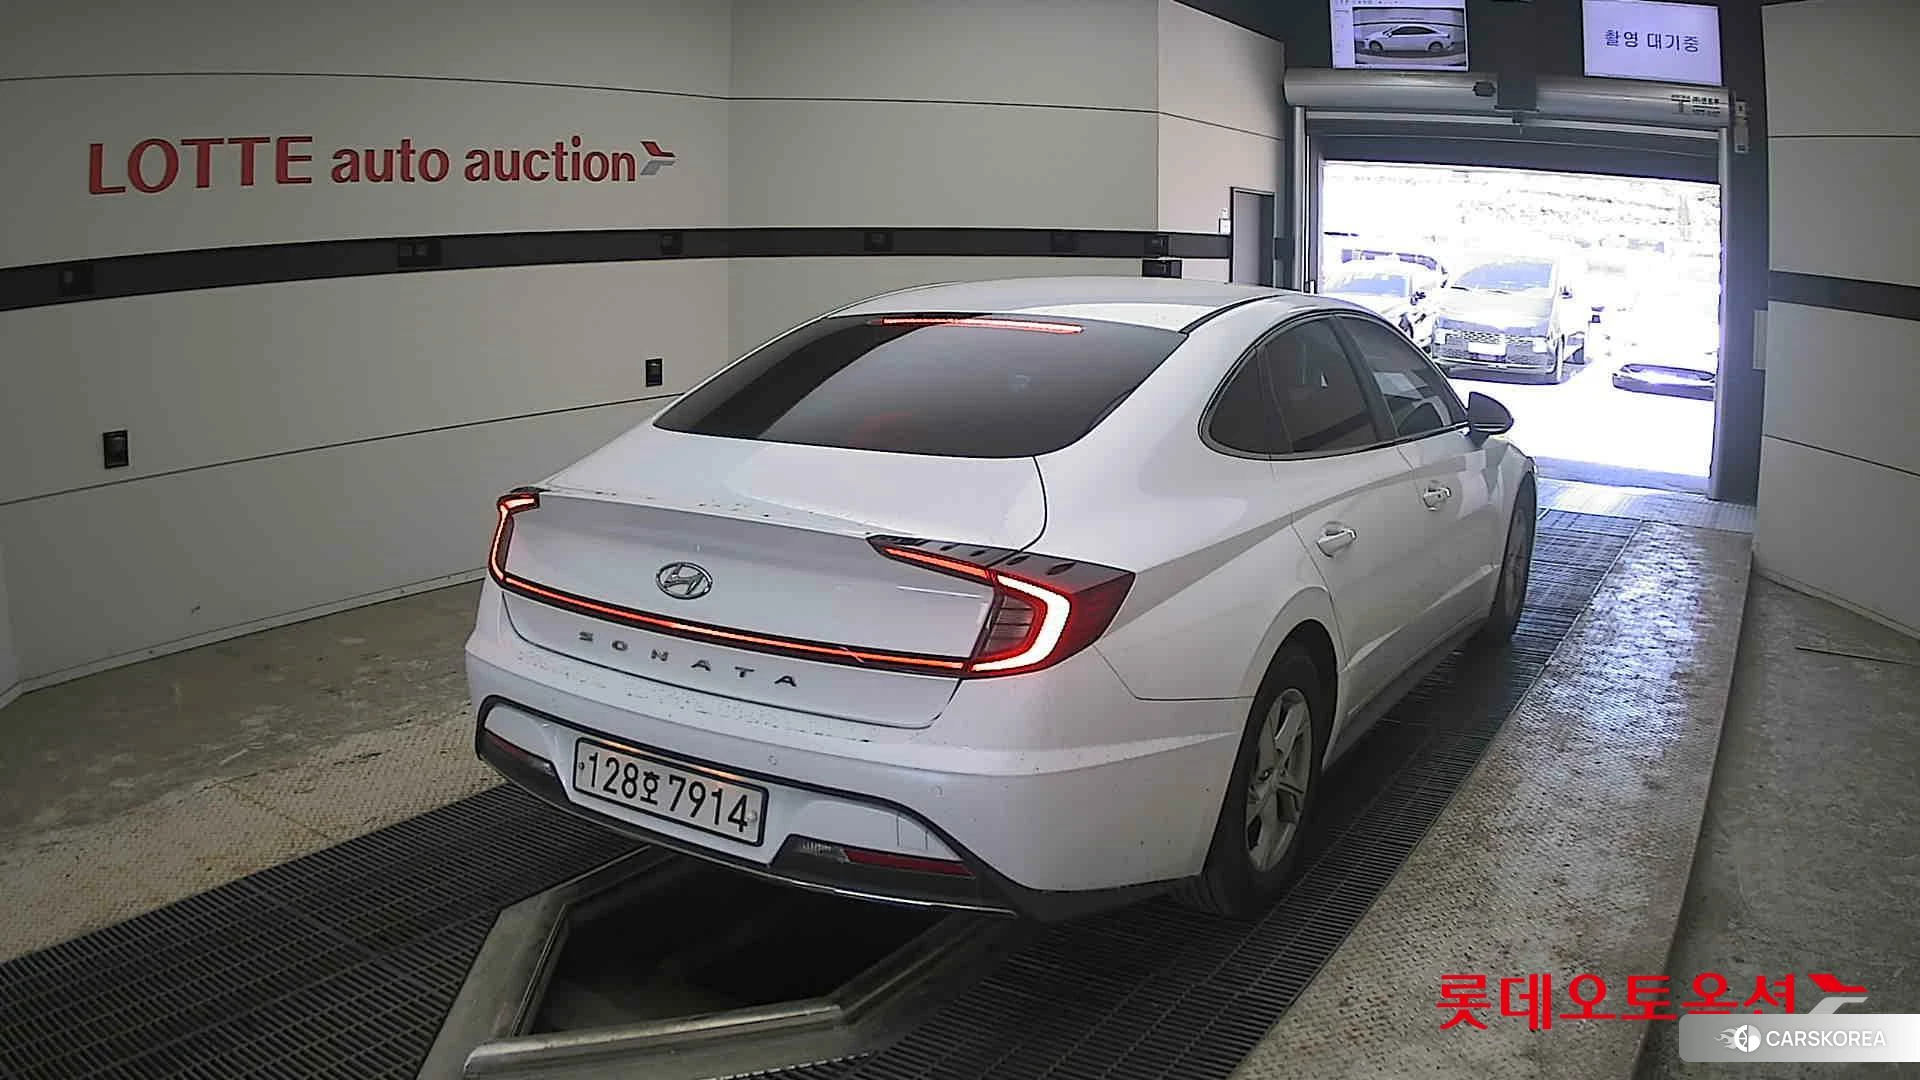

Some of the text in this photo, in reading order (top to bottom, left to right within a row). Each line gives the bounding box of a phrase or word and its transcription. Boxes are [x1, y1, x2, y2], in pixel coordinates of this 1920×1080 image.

[1606, 29, 1698, 53] 촬영 대기중
[89, 135, 637, 195] LOTTE auto auction
[578, 631, 798, 688] SONATA
[668, 774, 749, 833] 7914
